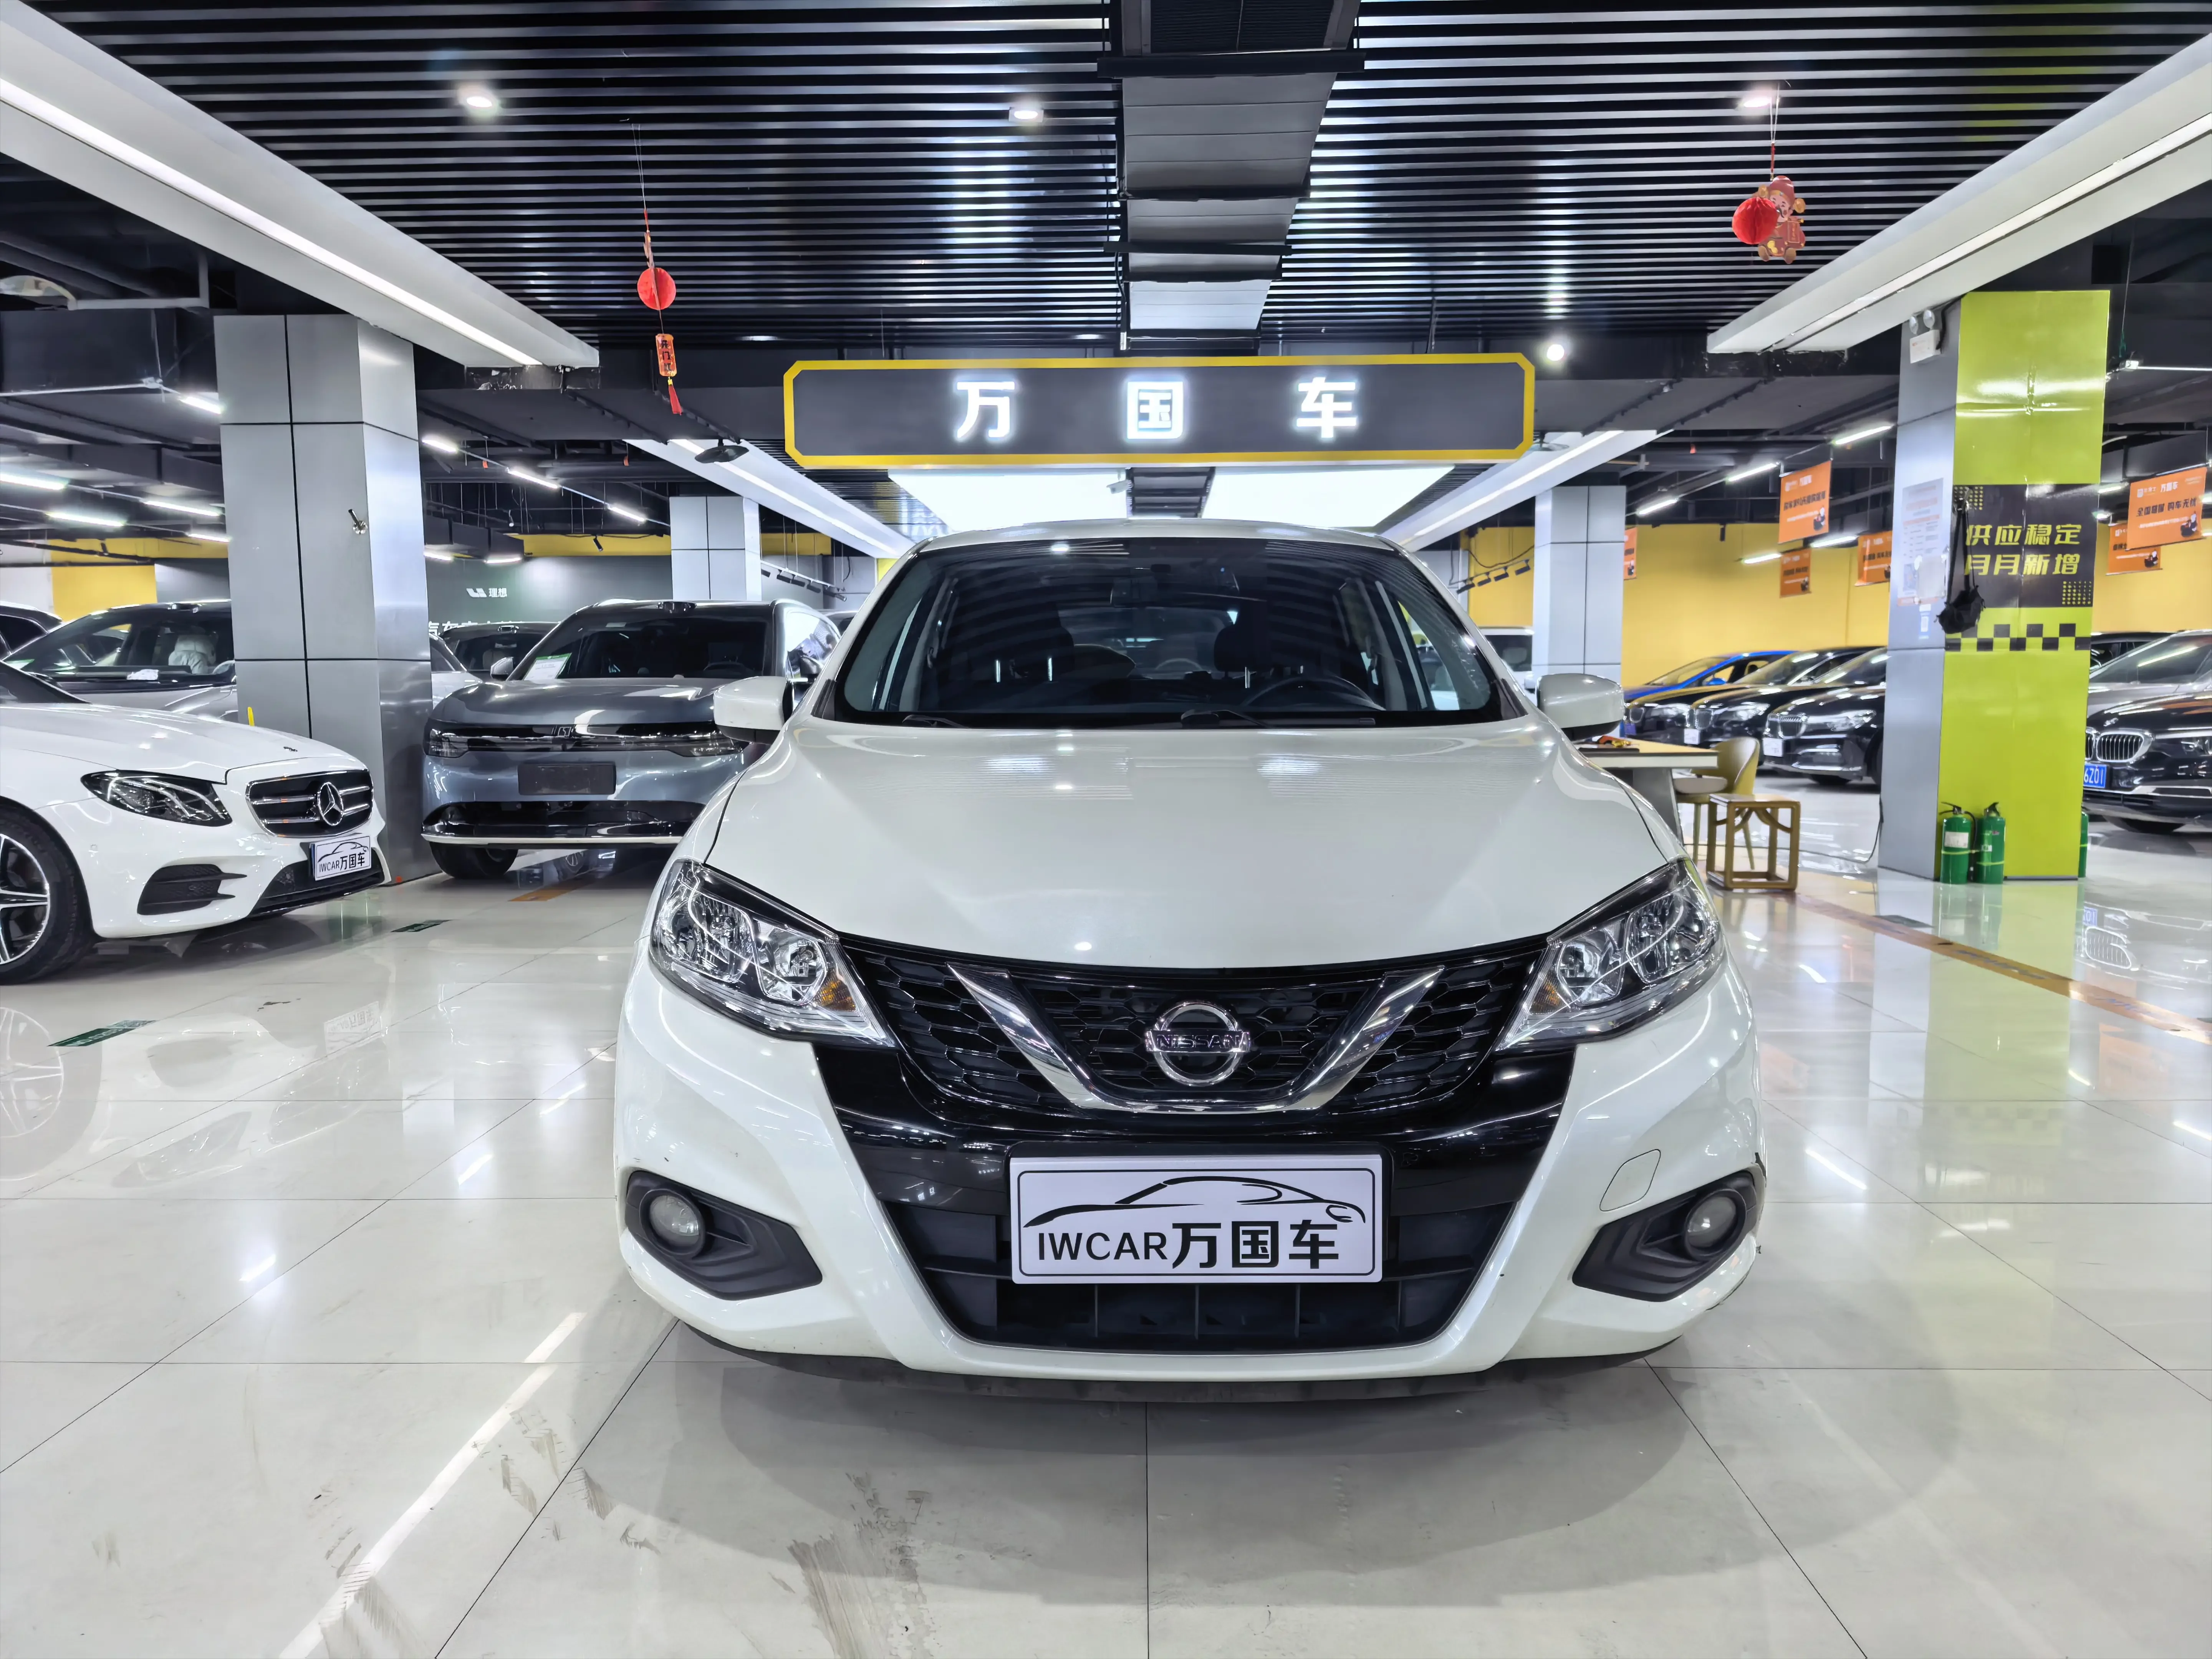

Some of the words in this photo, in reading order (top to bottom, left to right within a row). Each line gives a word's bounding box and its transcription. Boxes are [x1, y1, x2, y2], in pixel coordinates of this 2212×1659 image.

[955, 377, 1358, 440] 万国车
[1965, 524, 2082, 546] 供应稳定
[1964, 553, 2080, 575] 月月新增
[488, 588, 507, 598] 理想
[1157, 1034, 1240, 1049] NISSAN
